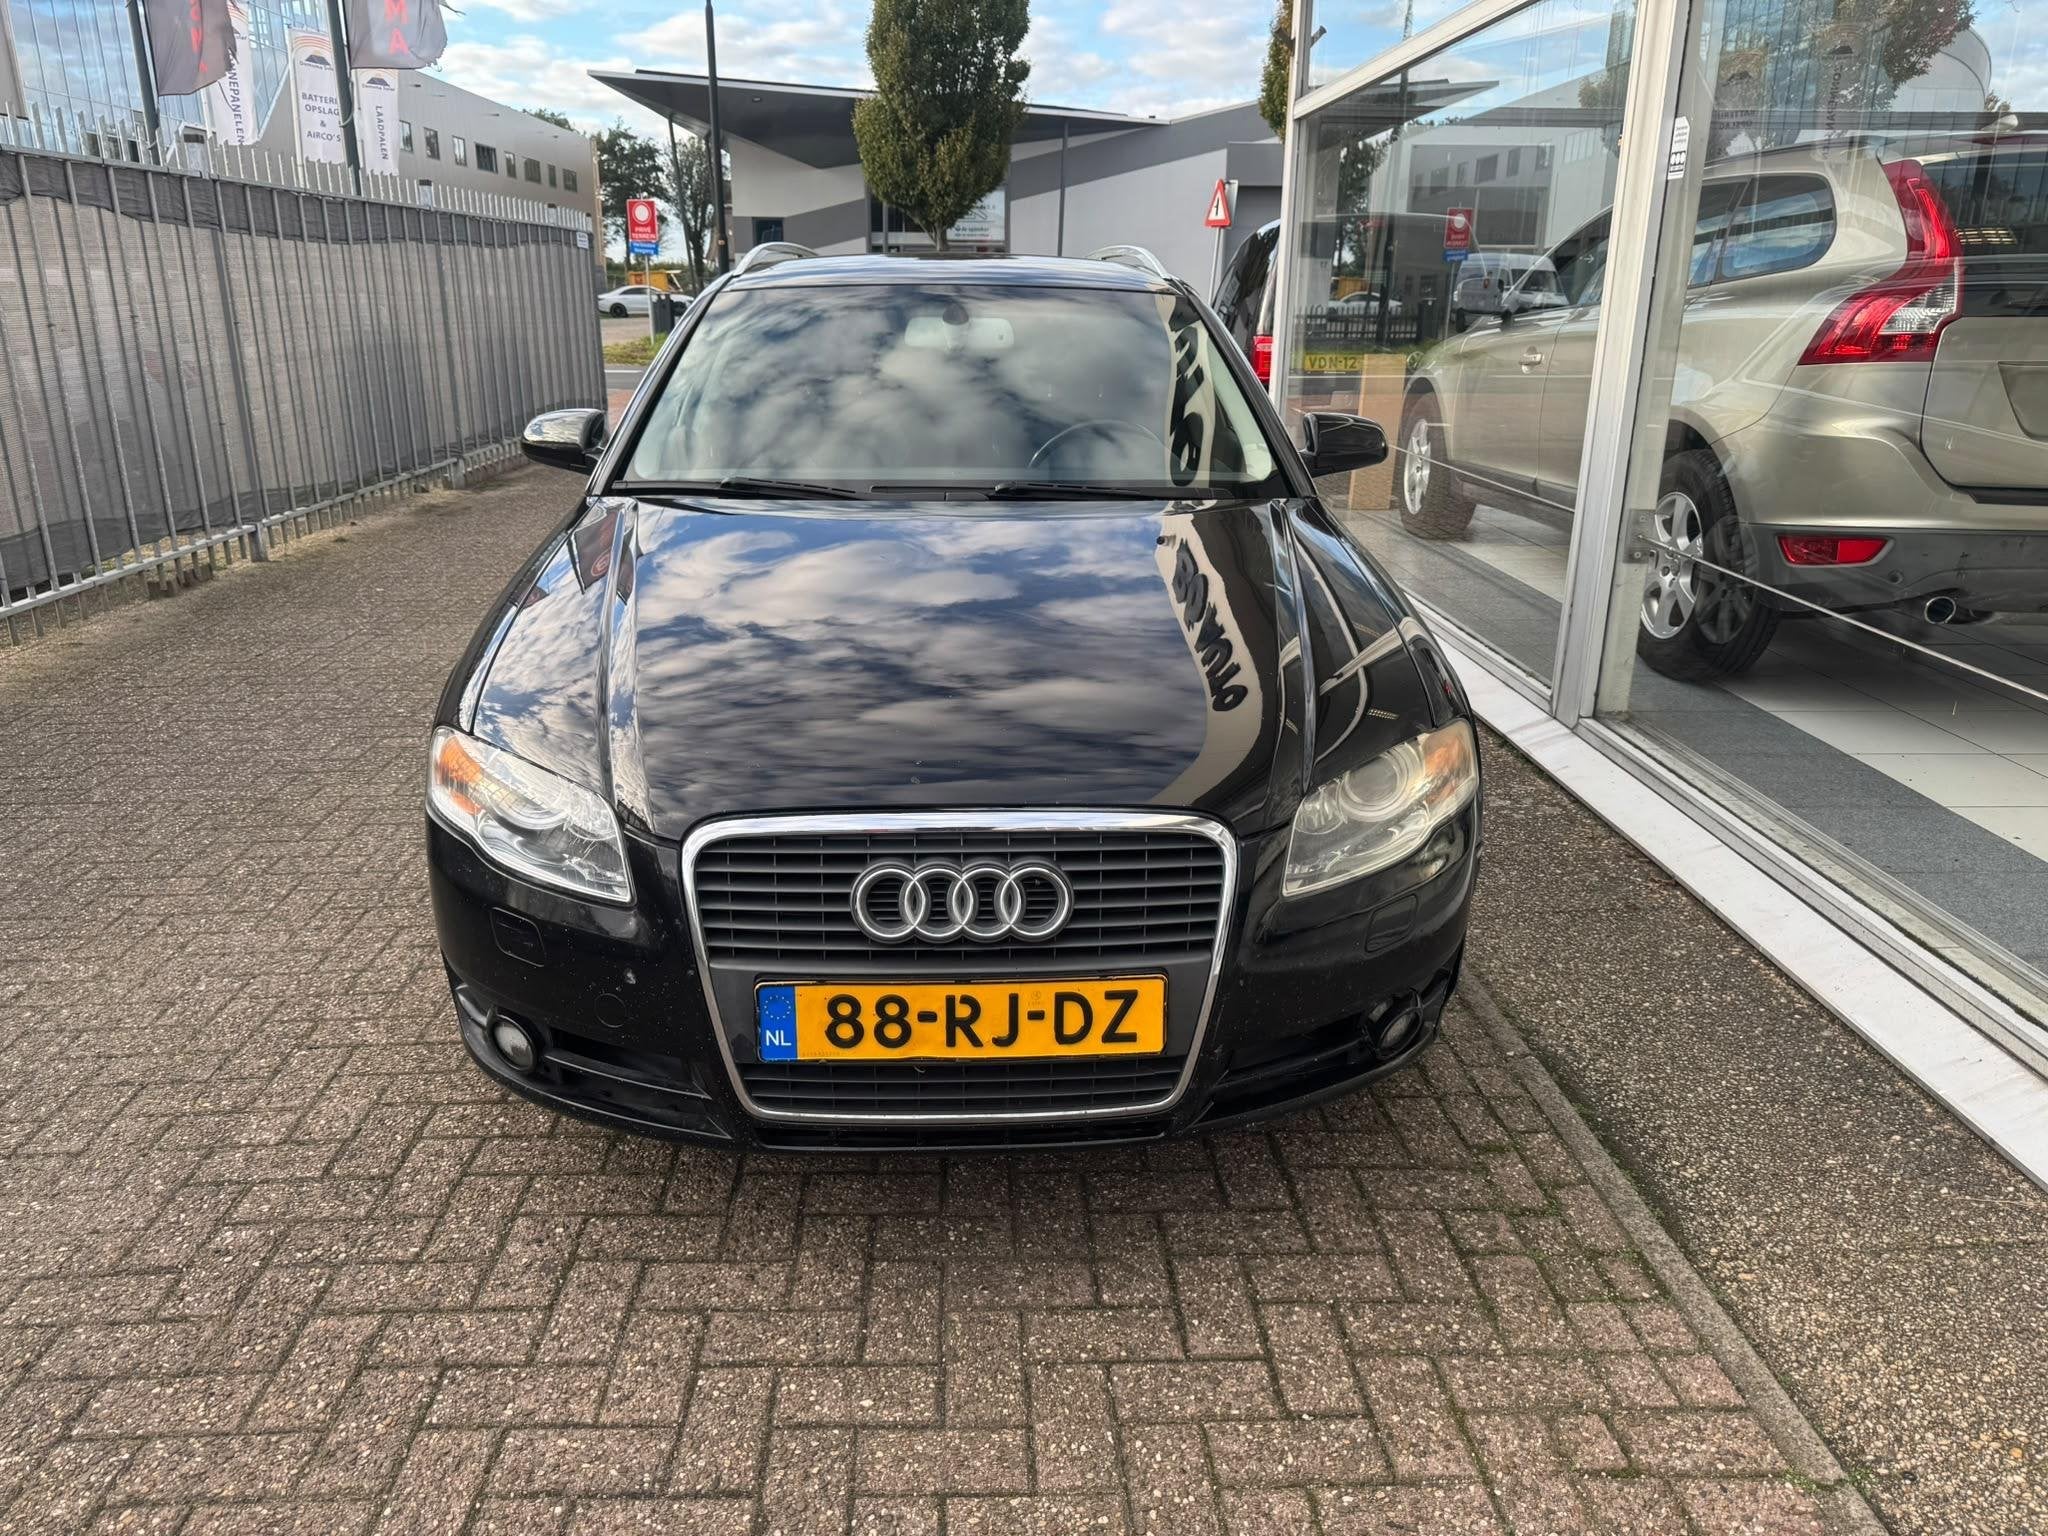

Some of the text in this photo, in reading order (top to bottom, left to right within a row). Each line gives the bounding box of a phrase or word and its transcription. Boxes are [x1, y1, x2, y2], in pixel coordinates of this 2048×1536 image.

[301, 92, 338, 104] BATTERI
[304, 104, 340, 116] OPSLAG
[375, 105, 389, 160] LAADPALEN
[1308, 356, 1360, 369] VDN-12
[824, 988, 1139, 1049] 88-RJ-DZ
[765, 1030, 792, 1047] NL
